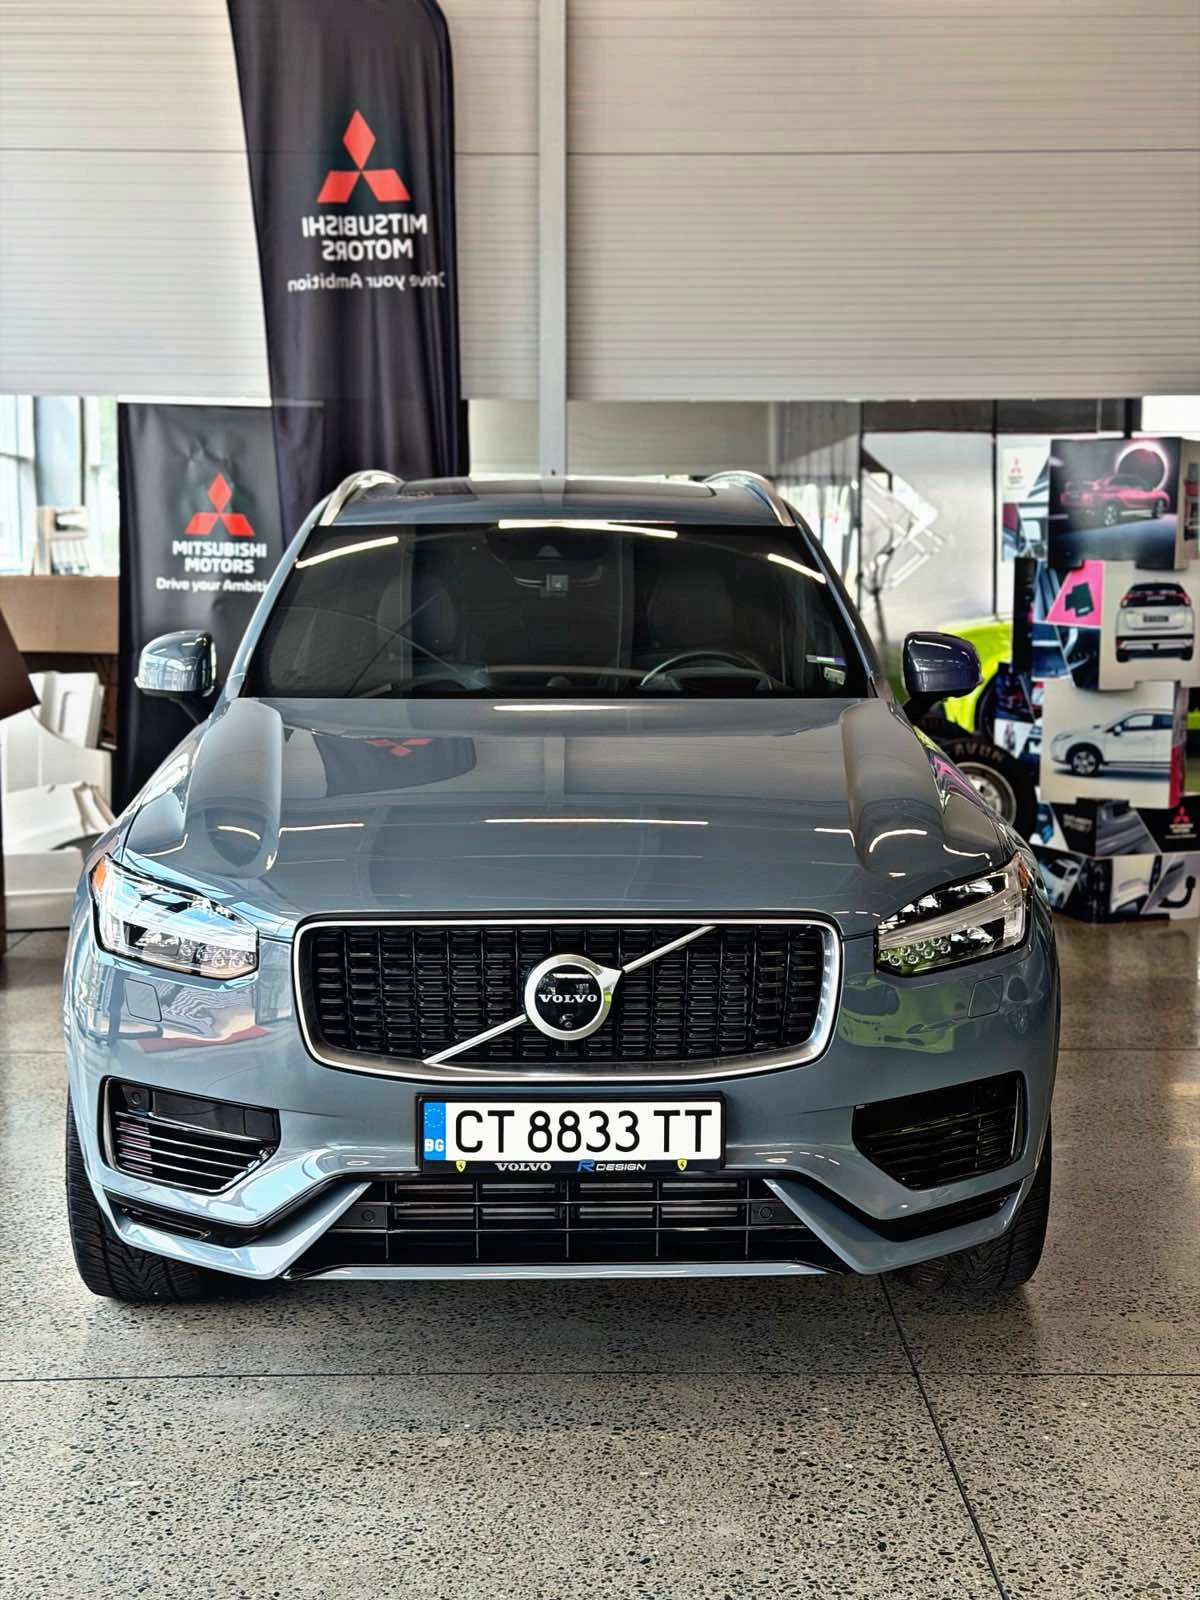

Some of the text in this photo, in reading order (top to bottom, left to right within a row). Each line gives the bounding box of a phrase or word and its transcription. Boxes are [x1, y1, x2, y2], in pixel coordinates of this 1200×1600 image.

[172, 540, 267, 558] MITSUBISHI
[184, 557, 255, 574] MOTORS
[156, 577, 268, 592] Drive your Ambiti
[538, 994, 598, 1003] VOLVO
[424, 1109, 712, 1153] BG CT 8833 TT
[494, 1162, 551, 1172] VOLVO
[595, 1163, 647, 1171] DESIGN
